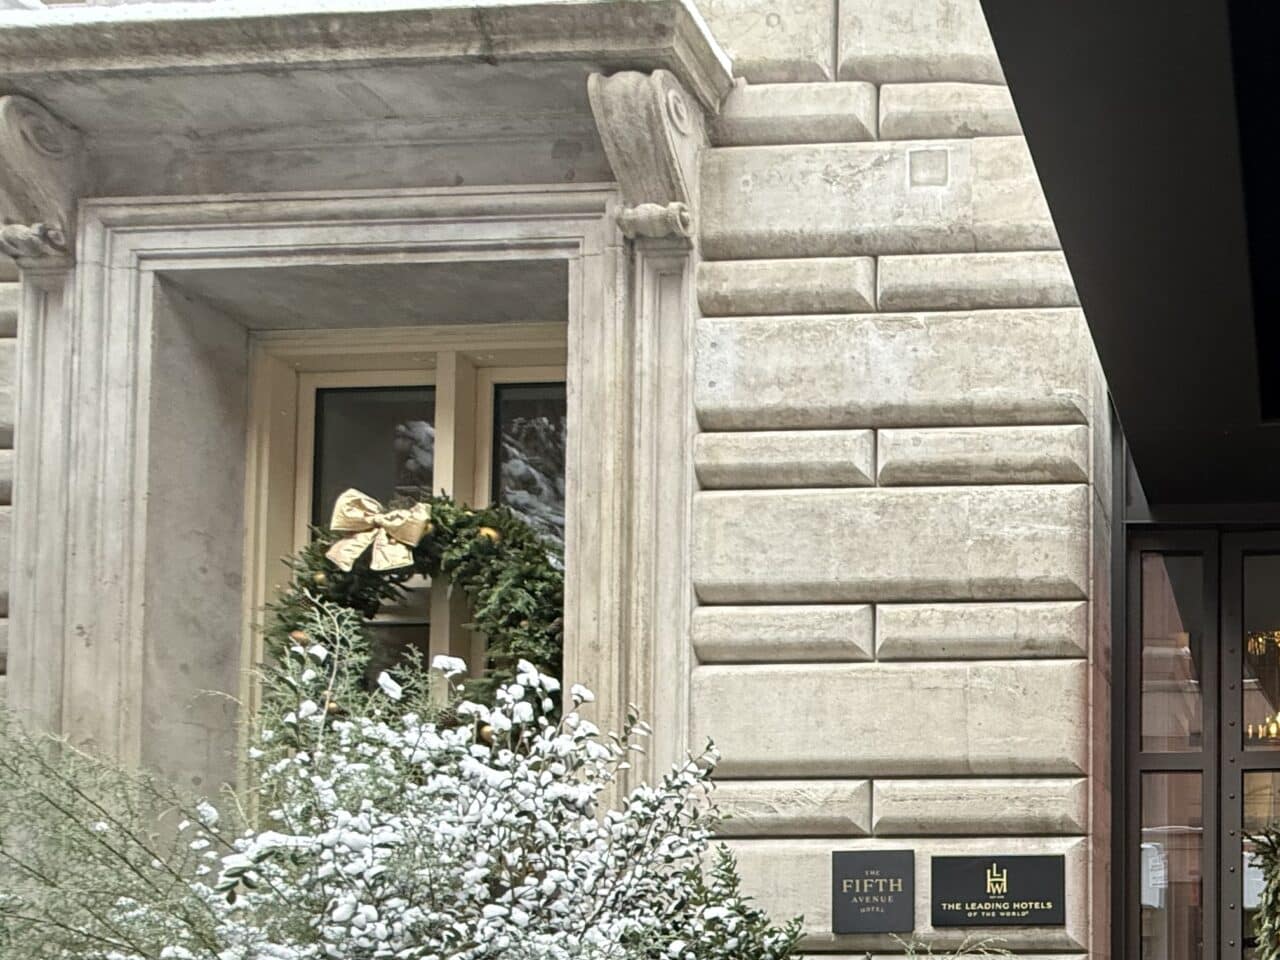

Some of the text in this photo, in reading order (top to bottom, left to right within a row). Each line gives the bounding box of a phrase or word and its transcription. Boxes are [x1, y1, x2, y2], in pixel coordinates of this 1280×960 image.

[842, 878, 904, 893] FIFTH
[851, 895, 894, 903] AVENUE
[941, 901, 1053, 911] THE LEADING HOTELS
